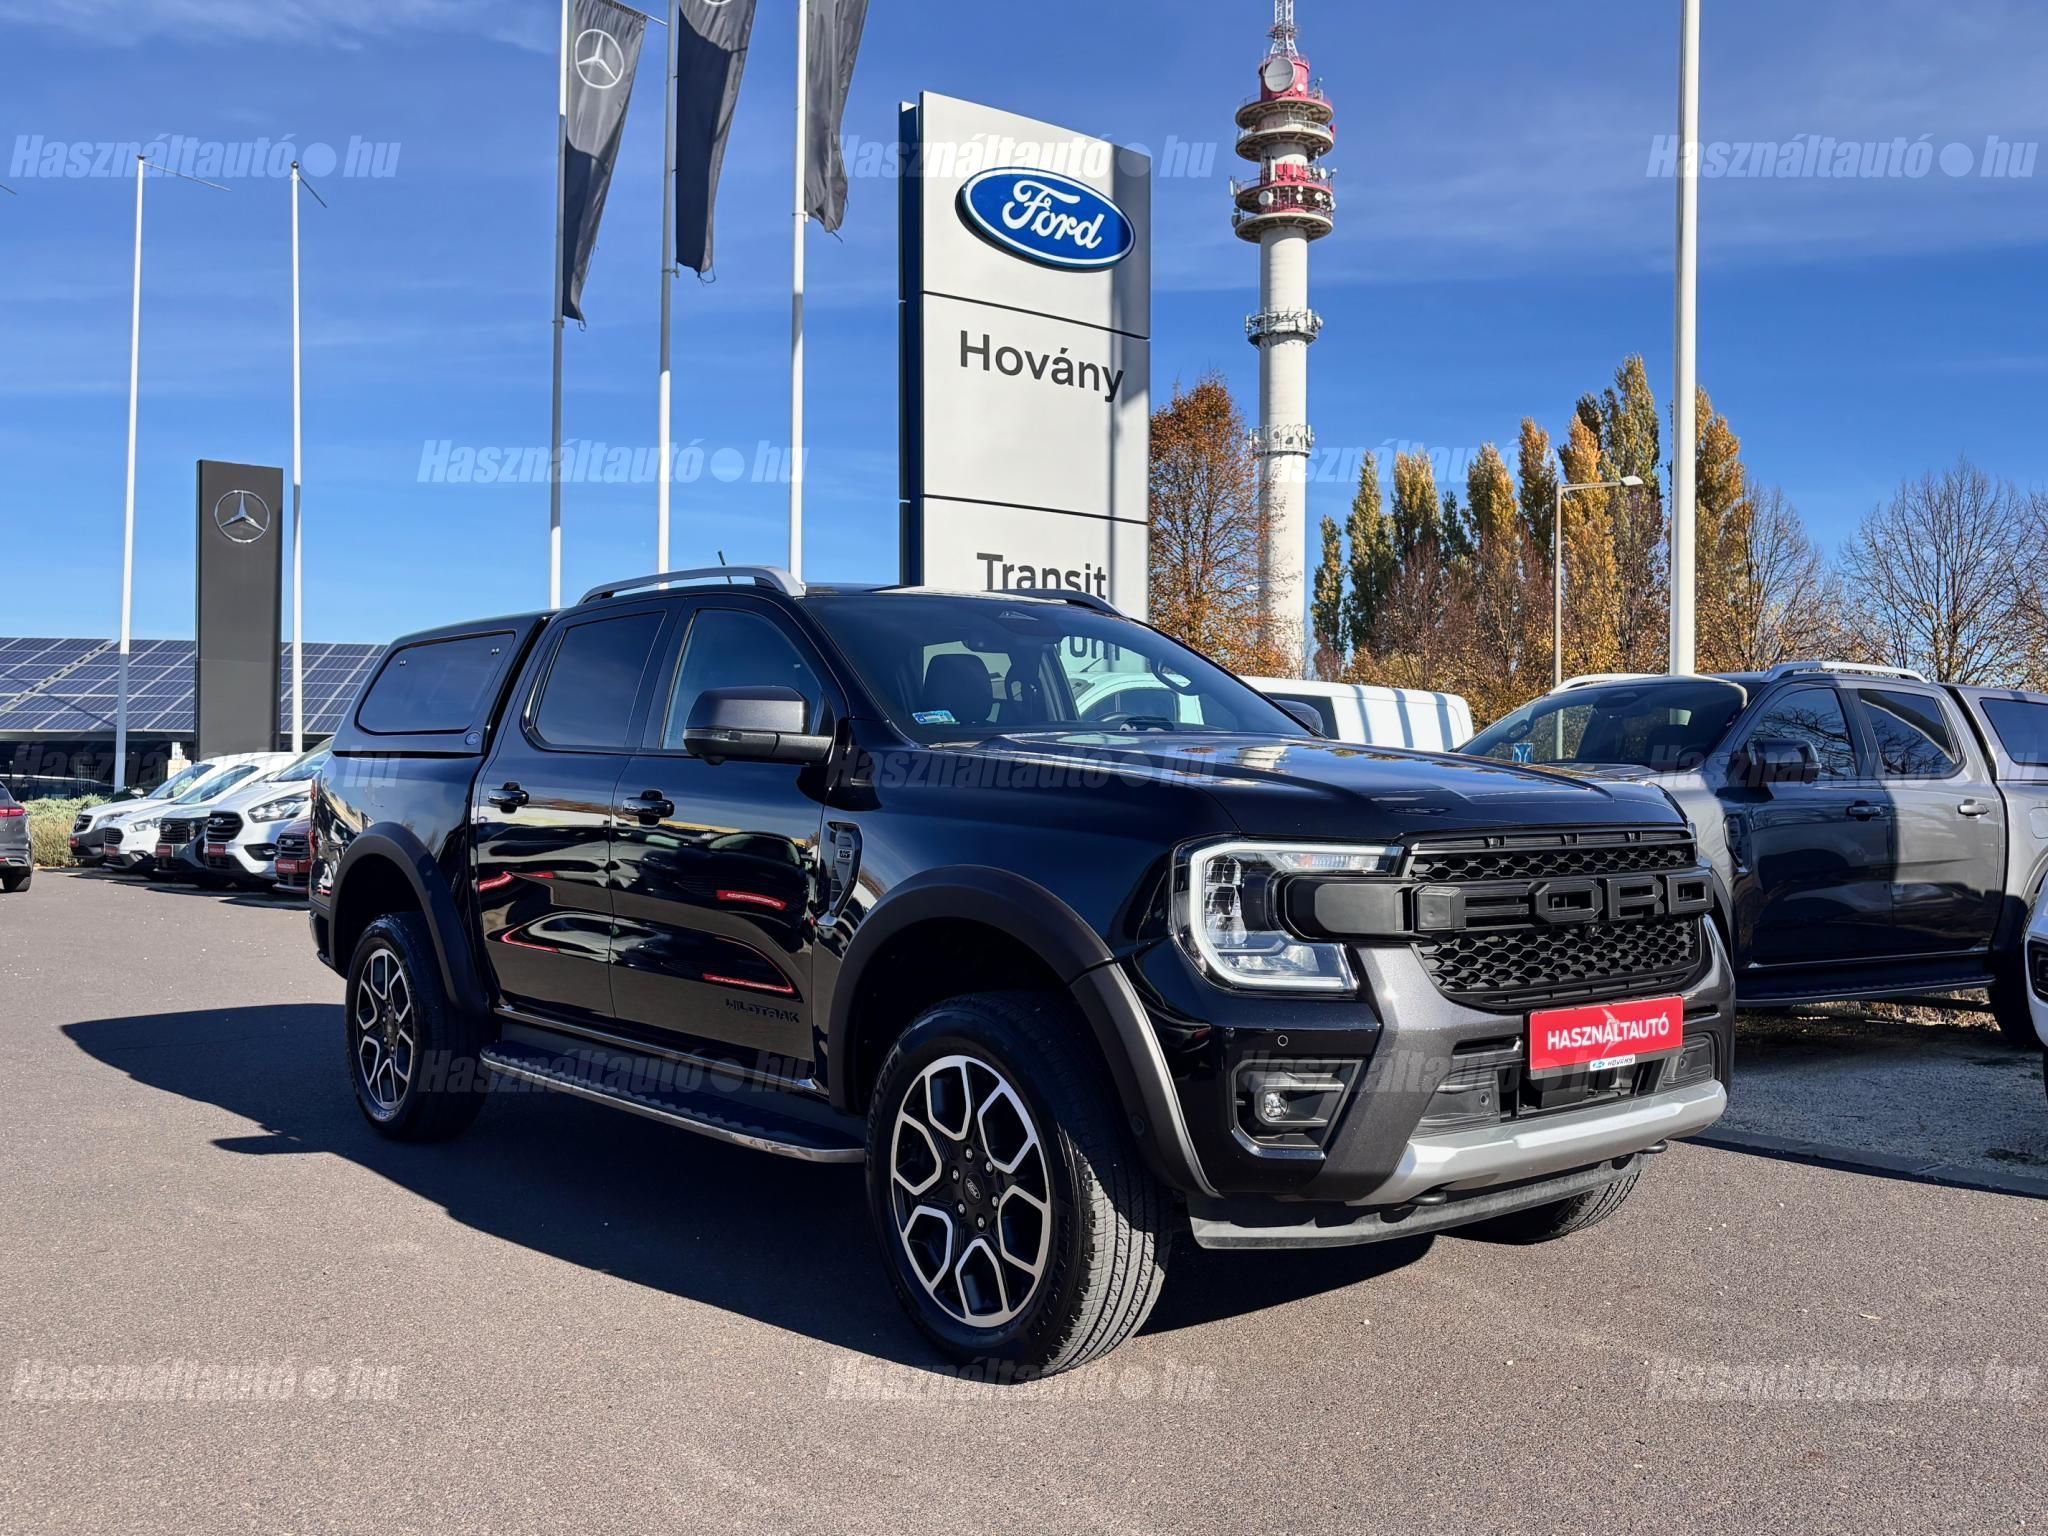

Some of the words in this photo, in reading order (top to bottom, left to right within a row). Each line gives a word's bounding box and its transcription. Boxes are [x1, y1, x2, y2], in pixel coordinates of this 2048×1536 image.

[1001, 180, 1105, 249] Ford
[960, 330, 1124, 402] Hovány
[976, 552, 1107, 600] Transit
[1416, 868, 1714, 931] FORD
[1547, 1011, 1670, 1051] HASZNÁLTAUTÓ
